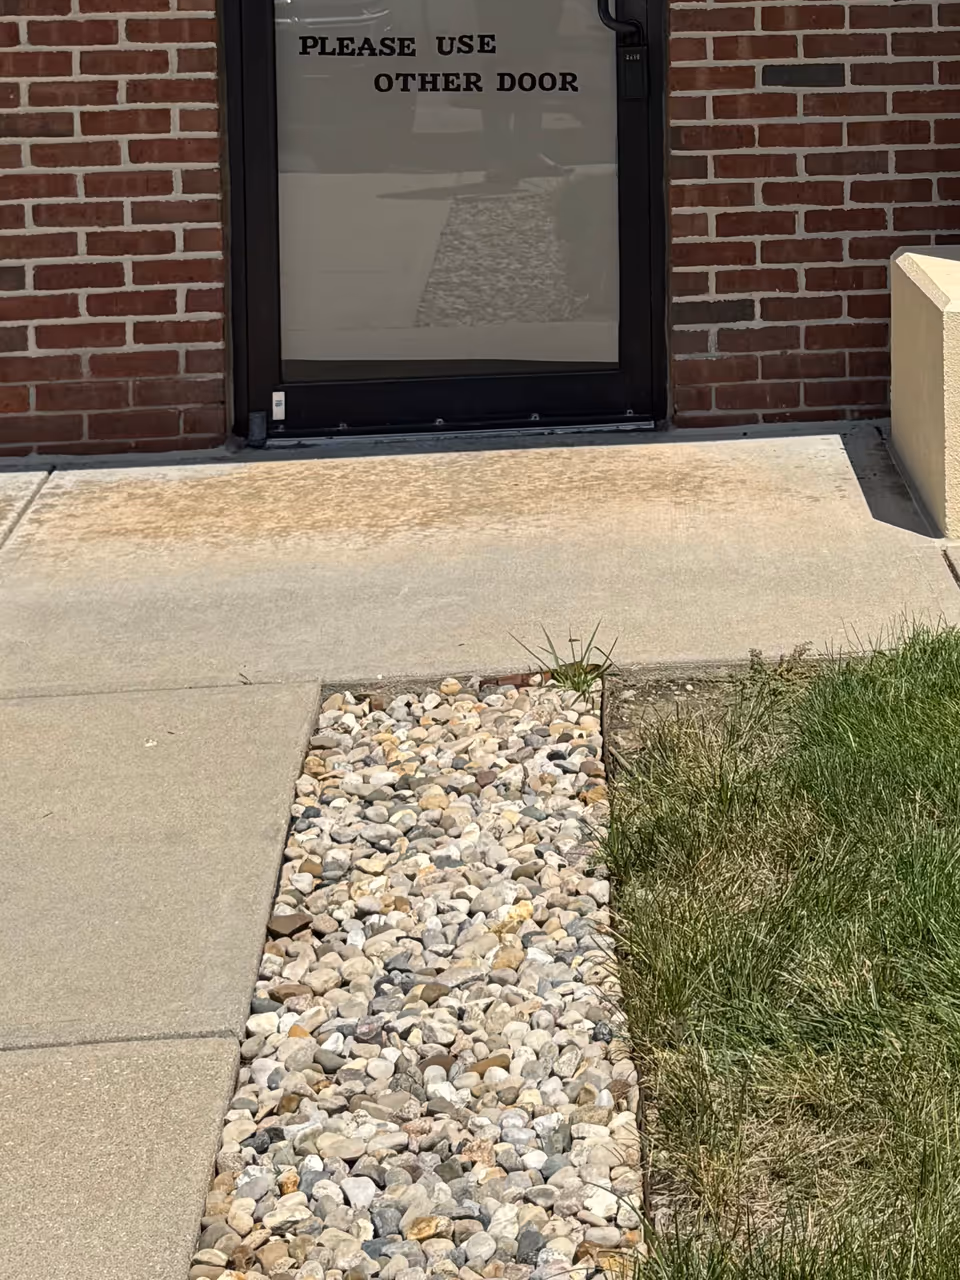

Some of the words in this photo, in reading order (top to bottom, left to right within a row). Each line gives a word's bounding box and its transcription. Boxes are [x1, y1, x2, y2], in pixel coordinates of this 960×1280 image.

[298, 35, 417, 57] PLEASE
[435, 34, 497, 56] USE
[373, 72, 484, 93] OTHER
[496, 71, 579, 93] DOOR
